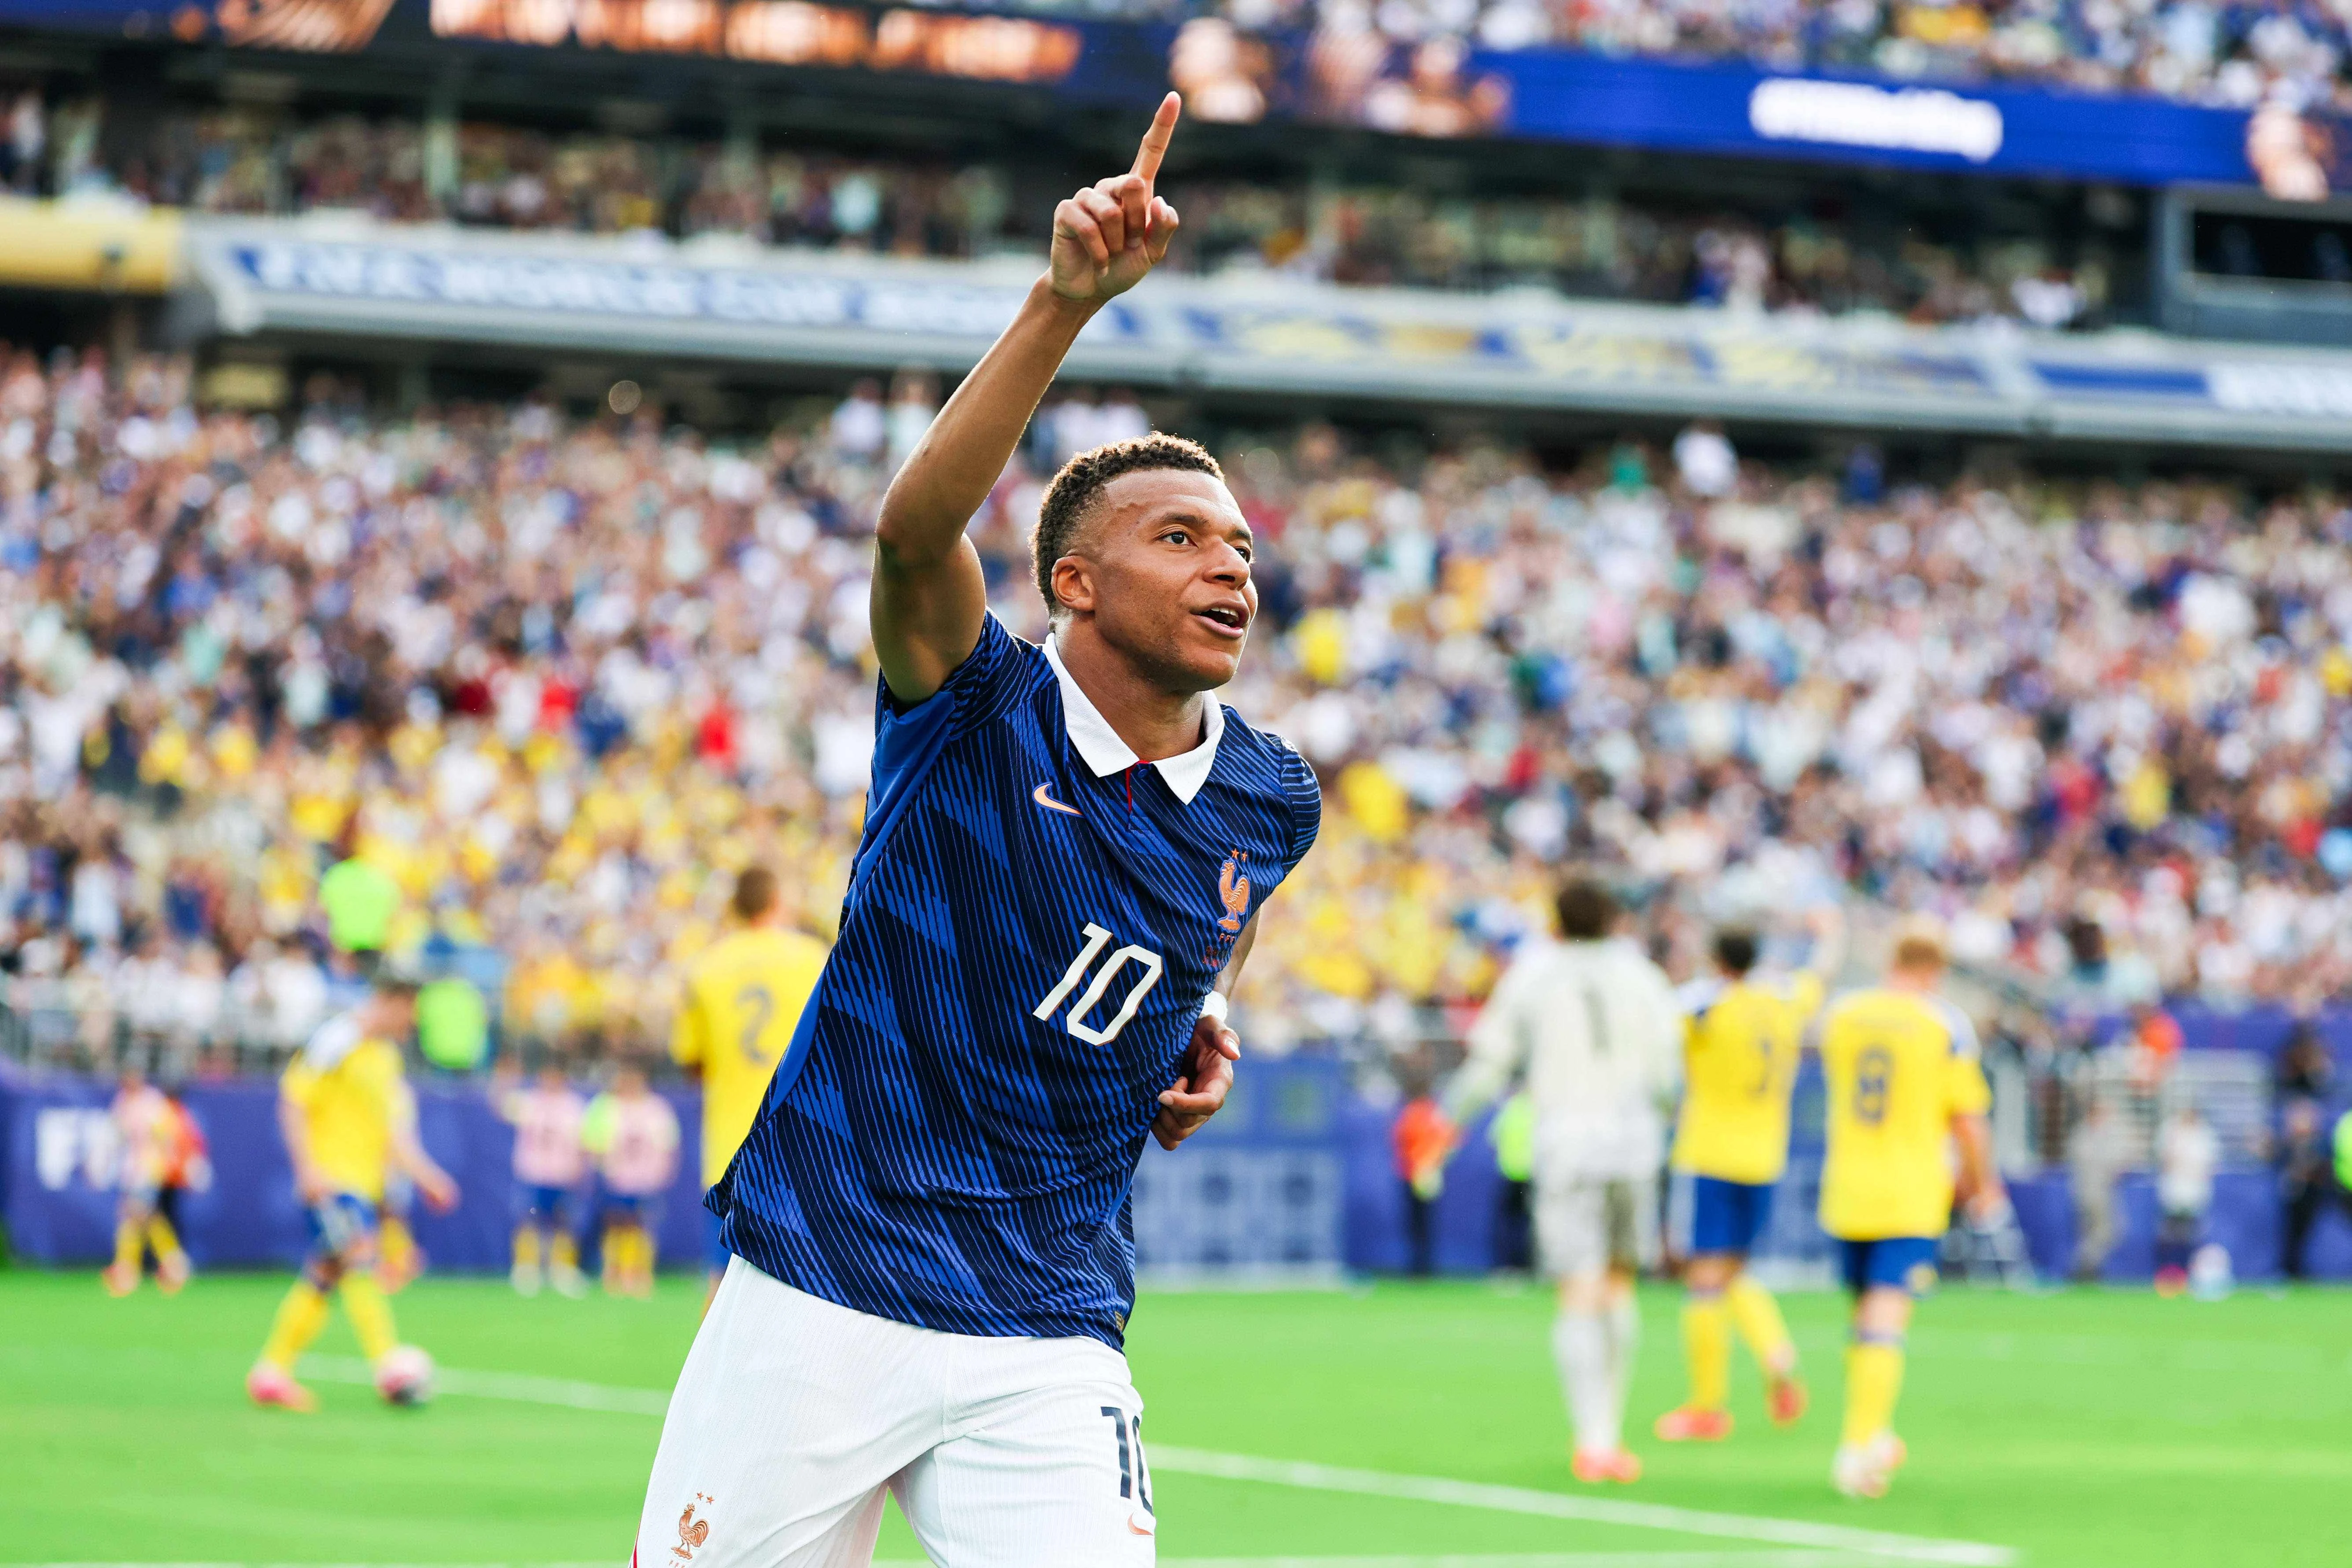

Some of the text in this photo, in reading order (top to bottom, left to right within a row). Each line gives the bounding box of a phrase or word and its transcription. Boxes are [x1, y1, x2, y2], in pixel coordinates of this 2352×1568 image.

[738, 983, 776, 1067] 2
[1032, 922, 1163, 1046] 10
[1854, 1045, 1894, 1125] 8
